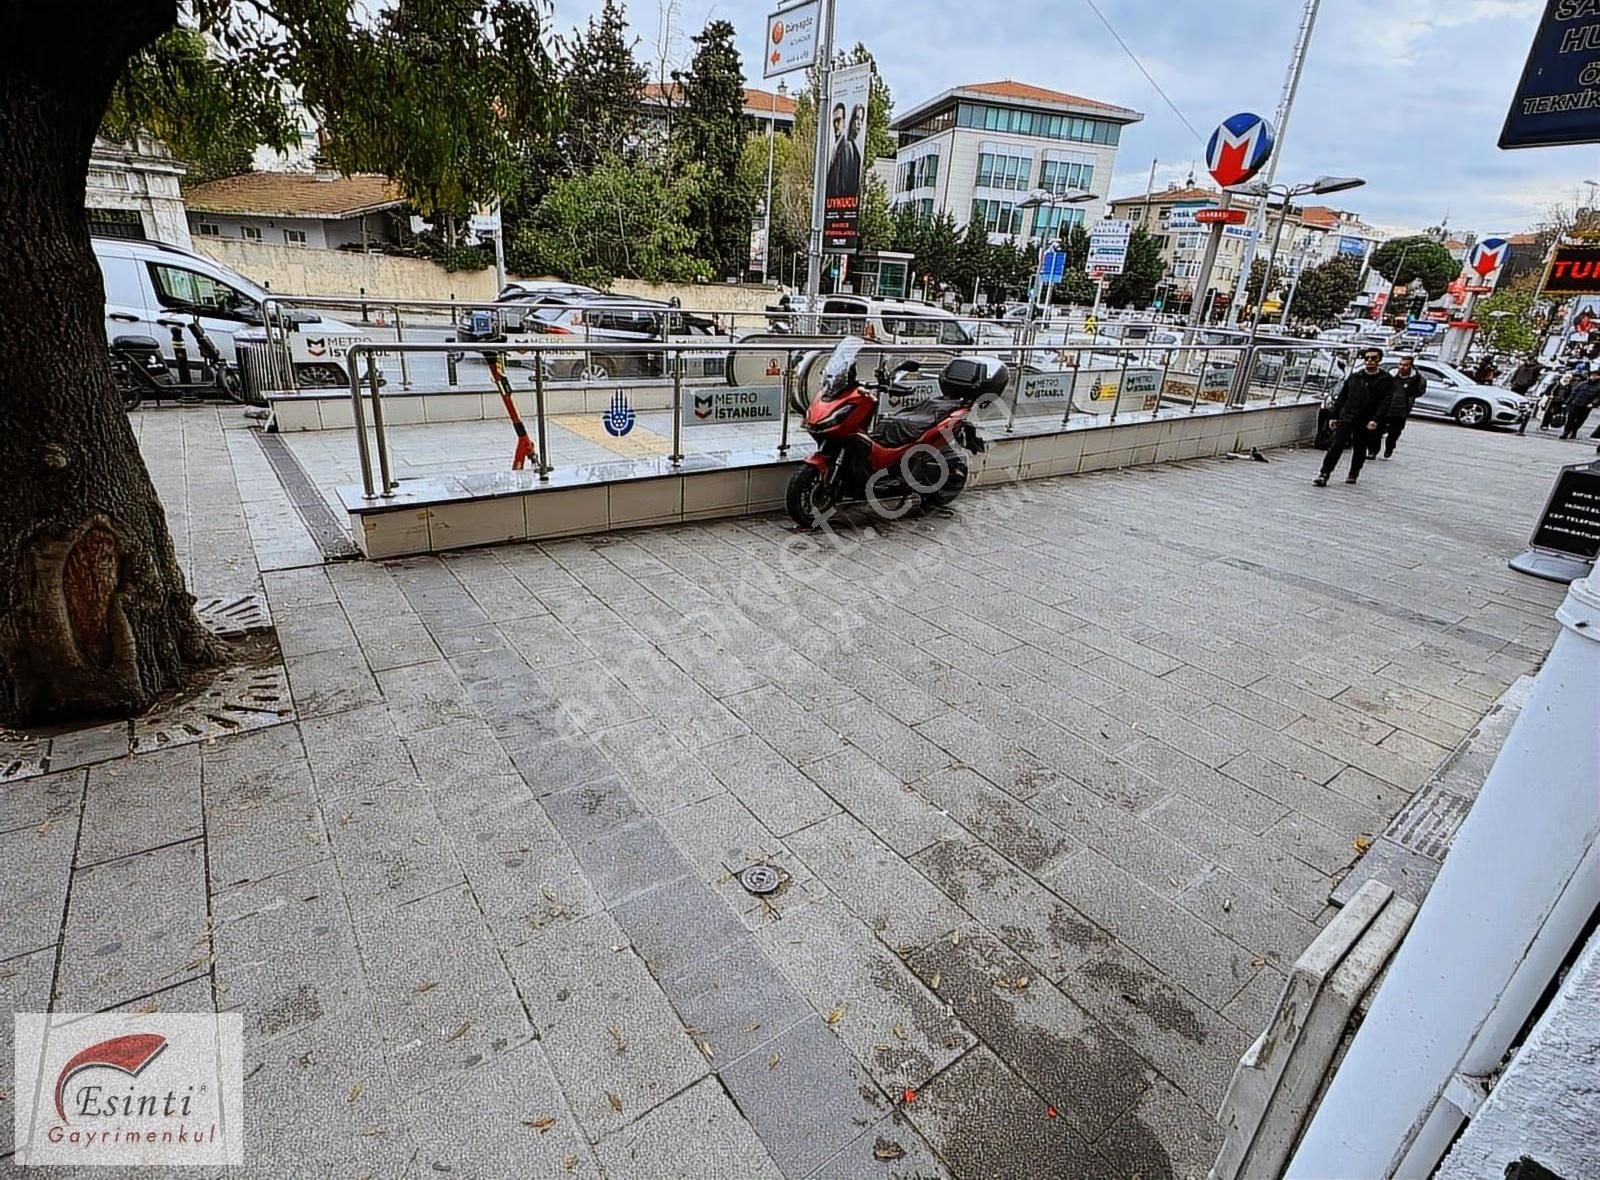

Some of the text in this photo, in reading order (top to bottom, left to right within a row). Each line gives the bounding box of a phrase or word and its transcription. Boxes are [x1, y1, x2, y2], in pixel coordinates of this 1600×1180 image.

[1523, 88, 1600, 115] TEKNİK
[714, 392, 758, 406] METRO
[714, 403, 773, 420] İSTANBUL
